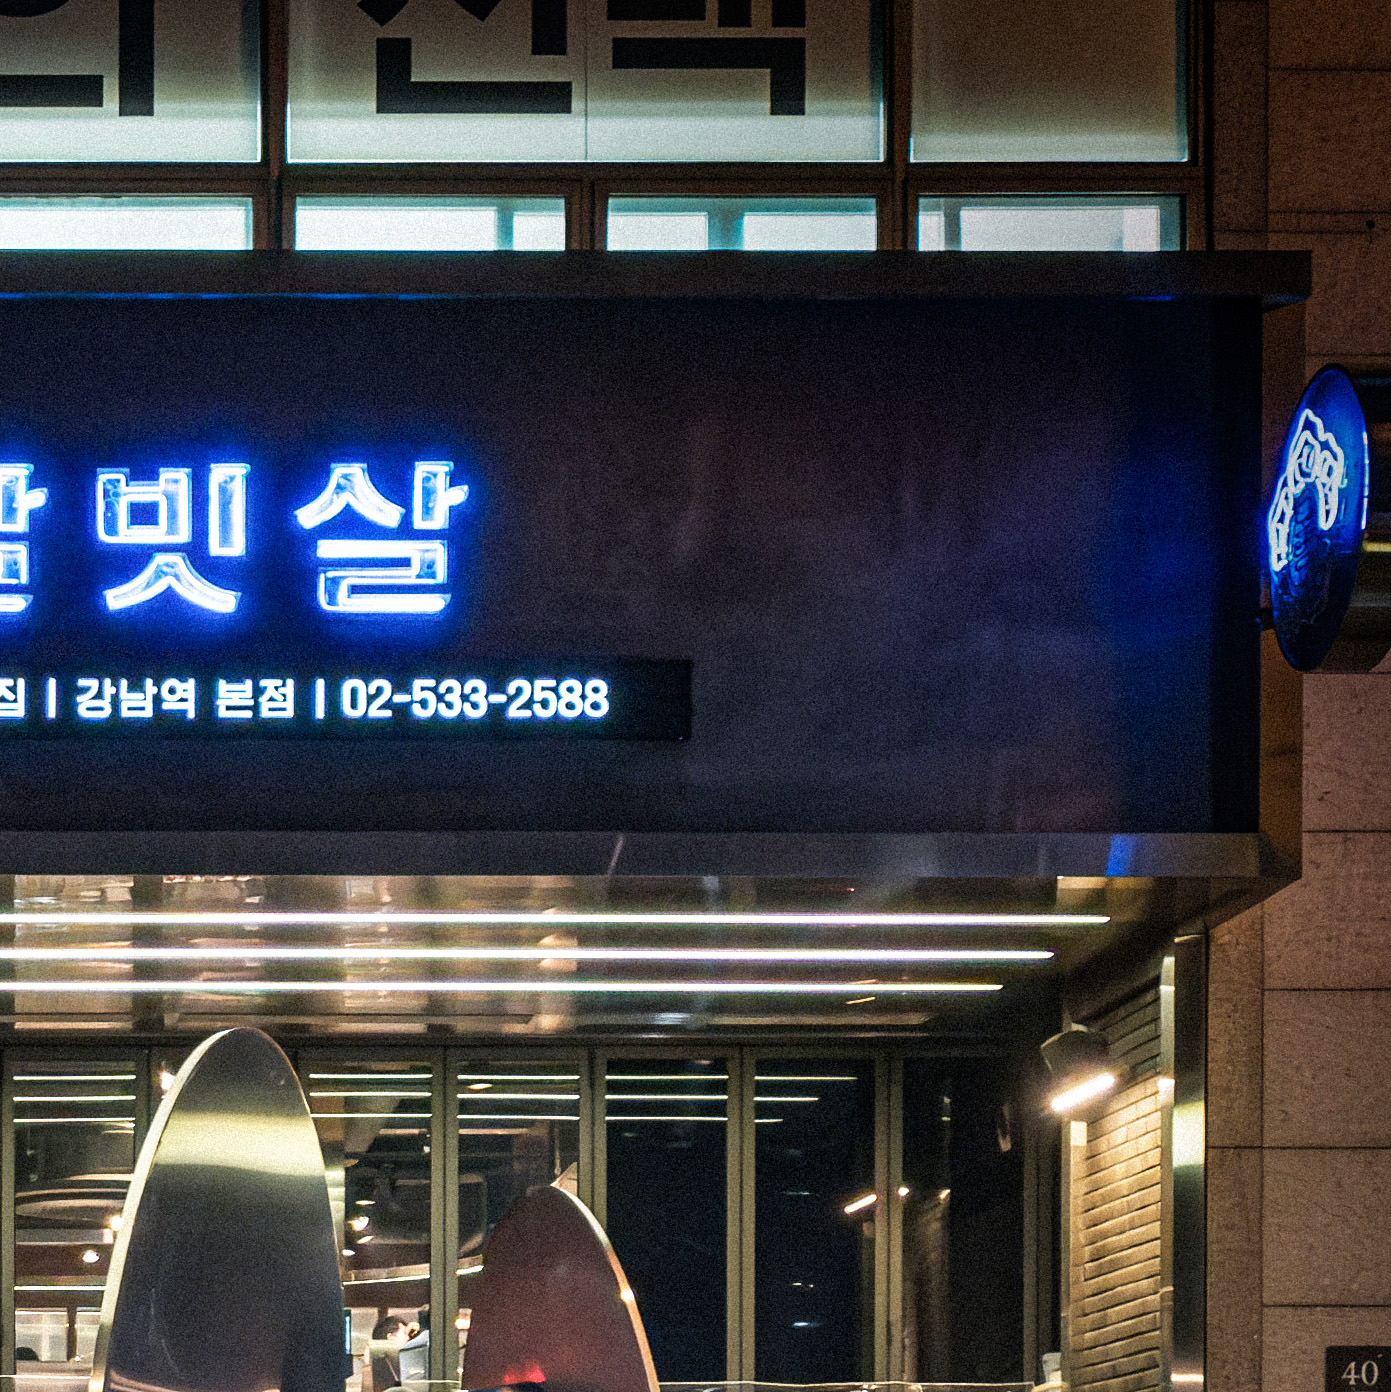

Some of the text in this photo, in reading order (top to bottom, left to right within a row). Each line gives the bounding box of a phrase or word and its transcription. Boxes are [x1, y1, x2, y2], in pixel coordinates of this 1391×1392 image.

[76, 678, 195, 719] 강남역
[215, 678, 294, 719] 본점
[341, 678, 609, 719] 02-533-2588
[1341, 1361, 1378, 1386] 40
